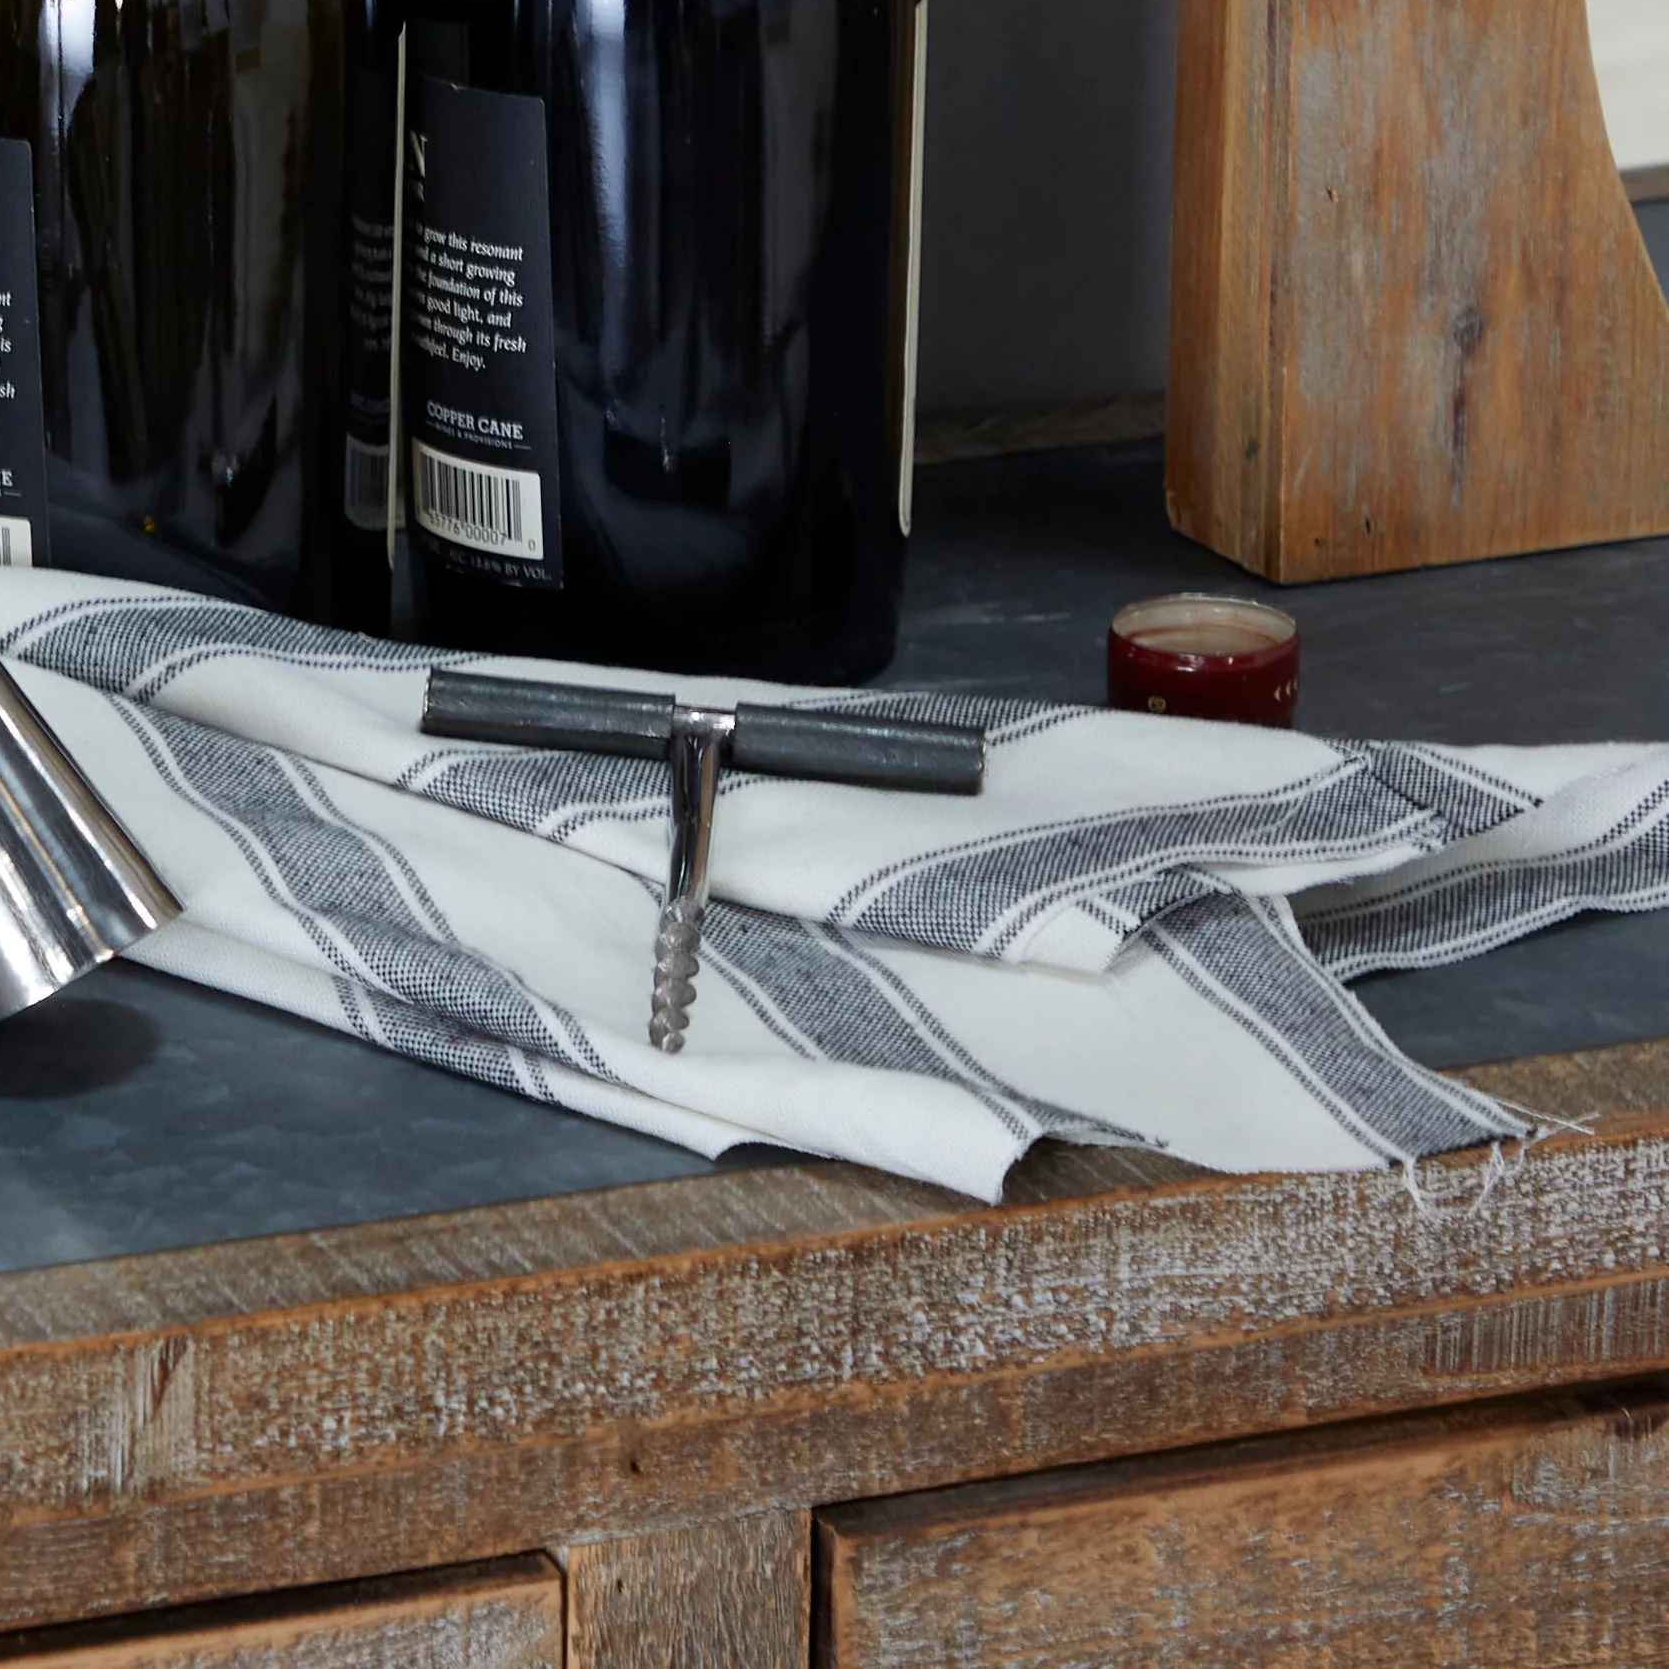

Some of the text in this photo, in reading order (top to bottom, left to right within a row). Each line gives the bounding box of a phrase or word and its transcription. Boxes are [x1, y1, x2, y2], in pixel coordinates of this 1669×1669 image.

[423, 227, 447, 245] grow
[448, 230, 468, 252] this
[470, 237, 524, 262] resonant
[430, 250, 437, 265] a
[438, 251, 464, 274] short
[465, 262, 516, 288] growing
[427, 269, 481, 300] foundation
[483, 285, 498, 308] of
[499, 287, 524, 308] this
[426, 293, 451, 314] good
[453, 299, 484, 325] light,
[487, 310, 512, 329] and
[433, 317, 473, 347] through
[476, 329, 491, 348] its
[493, 332, 527, 354] fresh
[452, 346, 486, 372] Enjoy.
[426, 399, 524, 440] COPPER CANE
[505, 561, 520, 577] BY
[522, 565, 552, 581] VOL.
